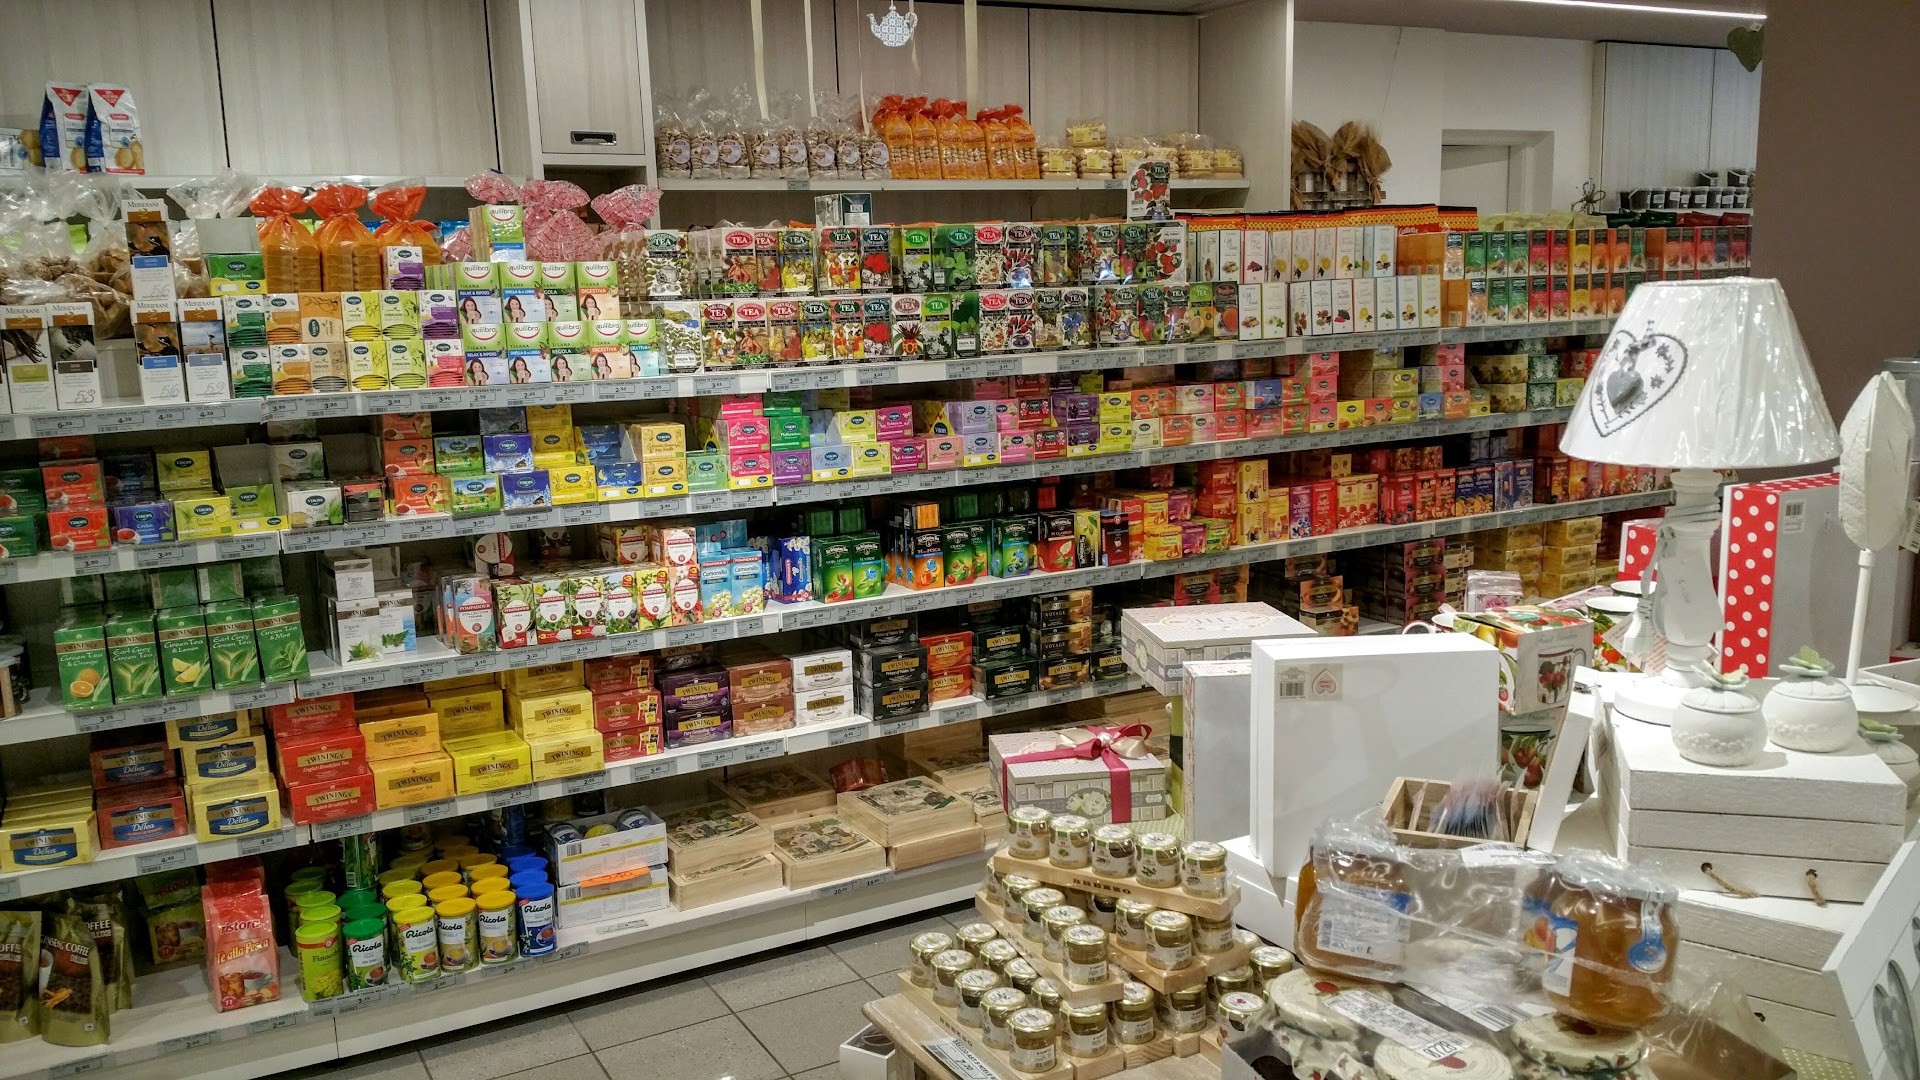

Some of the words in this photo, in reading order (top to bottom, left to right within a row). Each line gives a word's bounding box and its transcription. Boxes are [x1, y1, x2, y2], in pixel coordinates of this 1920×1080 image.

[836, 233, 851, 241] TEA
[869, 233, 884, 241] TEA
[955, 233, 968, 241] TEA
[982, 231, 996, 239] TEA
[654, 238, 671, 246] TEA
[731, 236, 747, 244] TEA
[789, 236, 805, 244] TEA
[743, 307, 759, 315] TEA
[775, 306, 792, 315] TEA
[808, 305, 824, 313] TEA
[840, 304, 855, 313] TEA
[869, 303, 884, 312] TEA
[710, 308, 727, 317] TEA
[260, 629, 282, 637] Green
[275, 632, 292, 640] Mint
[229, 634, 250, 642] Grey
[130, 647, 151, 655] Grey
[60, 654, 85, 662] Green
[542, 707, 575, 719] TWININGS
[383, 728, 420, 741] TWININGS
[306, 751, 346, 766] TWININGS
[551, 749, 584, 761] TWININGS
[303, 765, 322, 773] English
[477, 762, 512, 774] TWININGS
[397, 775, 433, 788] TWININGS
[315, 790, 352, 804] TWININGS
[524, 902, 551, 914] Ricola
[479, 914, 507, 924] Ricola
[438, 921, 463, 931] Ricola
[405, 926, 434, 939] Ricola
[65, 942, 90, 957] COFFEE
[227, 946, 244, 962] alla
[245, 939, 270, 955] Pesca
[352, 941, 382, 953] Ricola
